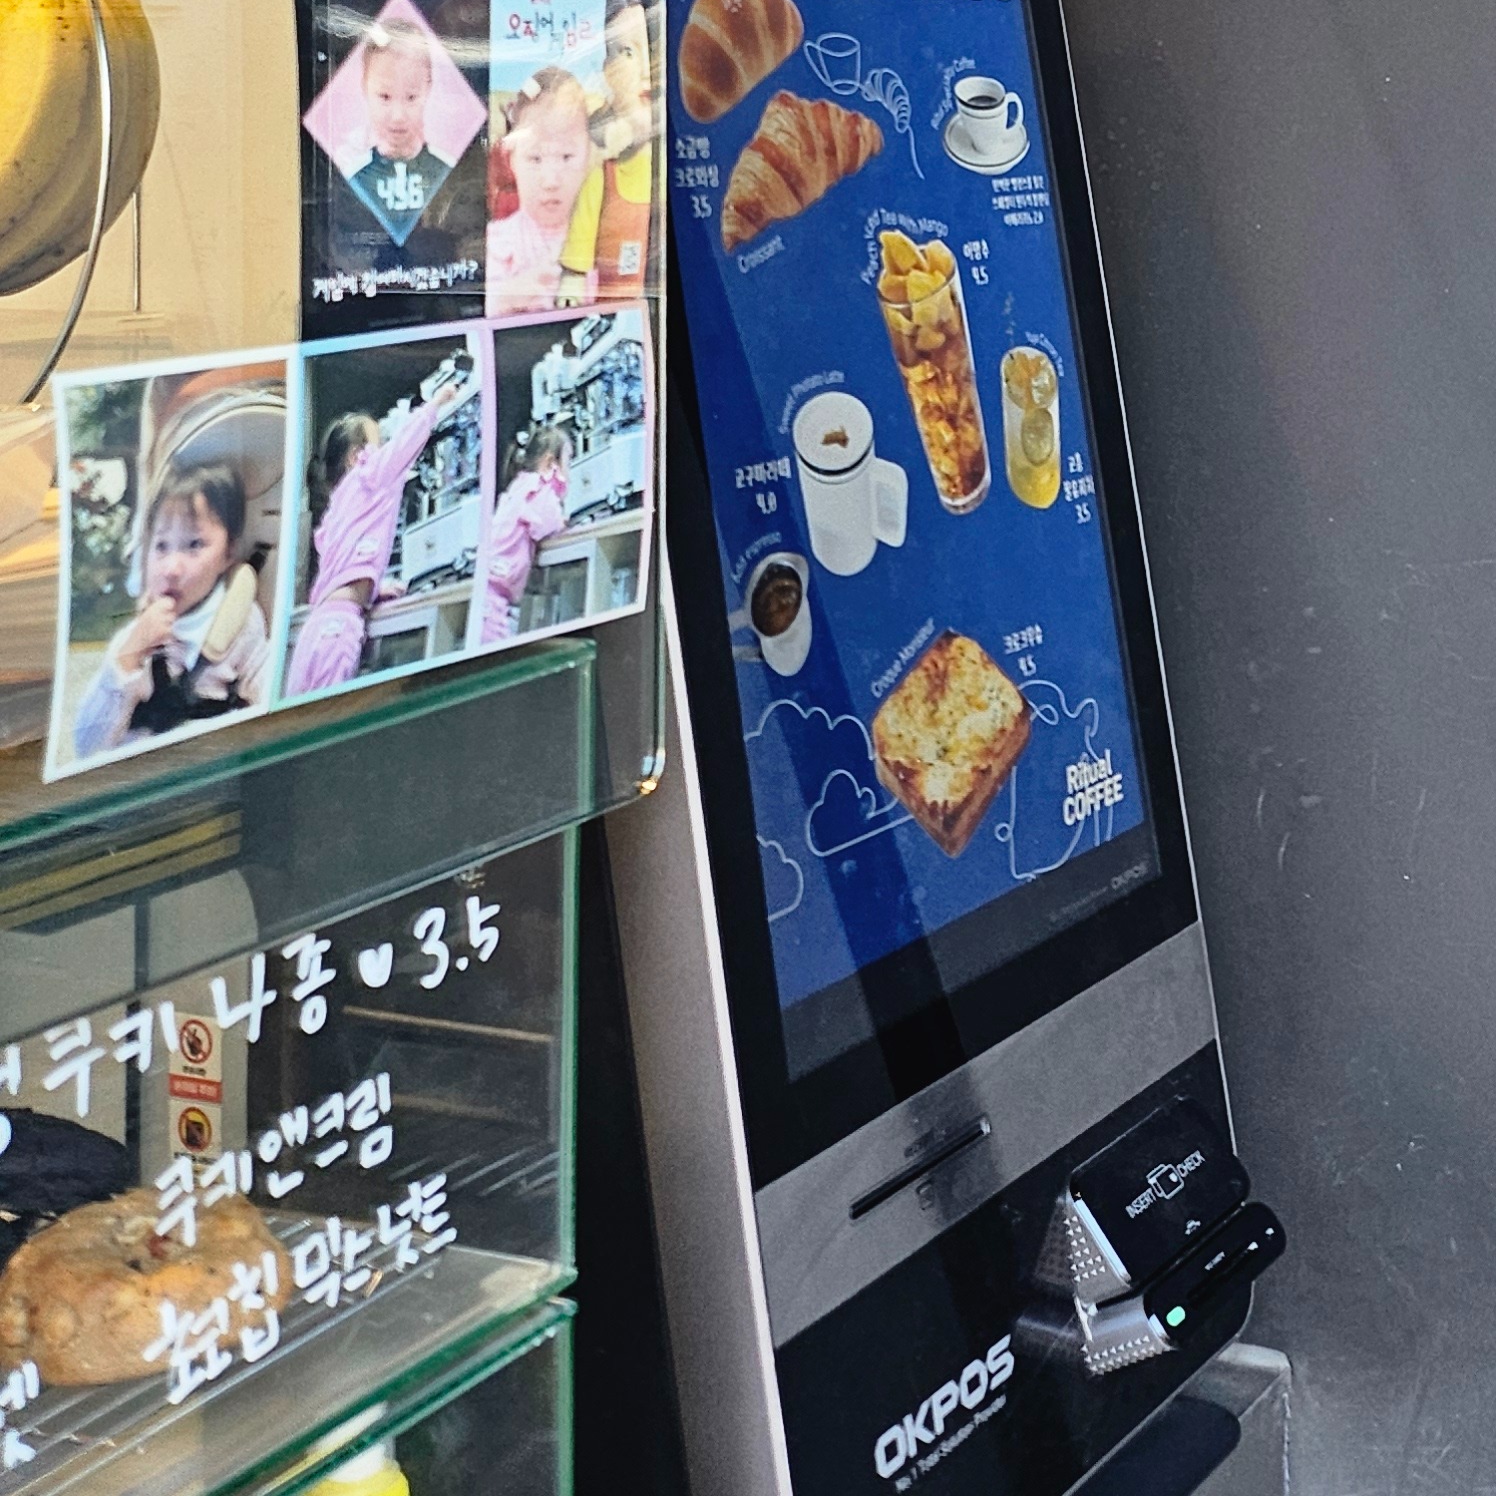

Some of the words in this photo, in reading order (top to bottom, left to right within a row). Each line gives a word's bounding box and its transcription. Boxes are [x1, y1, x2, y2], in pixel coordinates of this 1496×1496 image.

[1063, 773, 1125, 826] COFFEE
[43, 1002, 178, 1118] 쿠키
[413, 895, 501, 990] 3.5
[873, 1333, 1015, 1479] OKPOS
